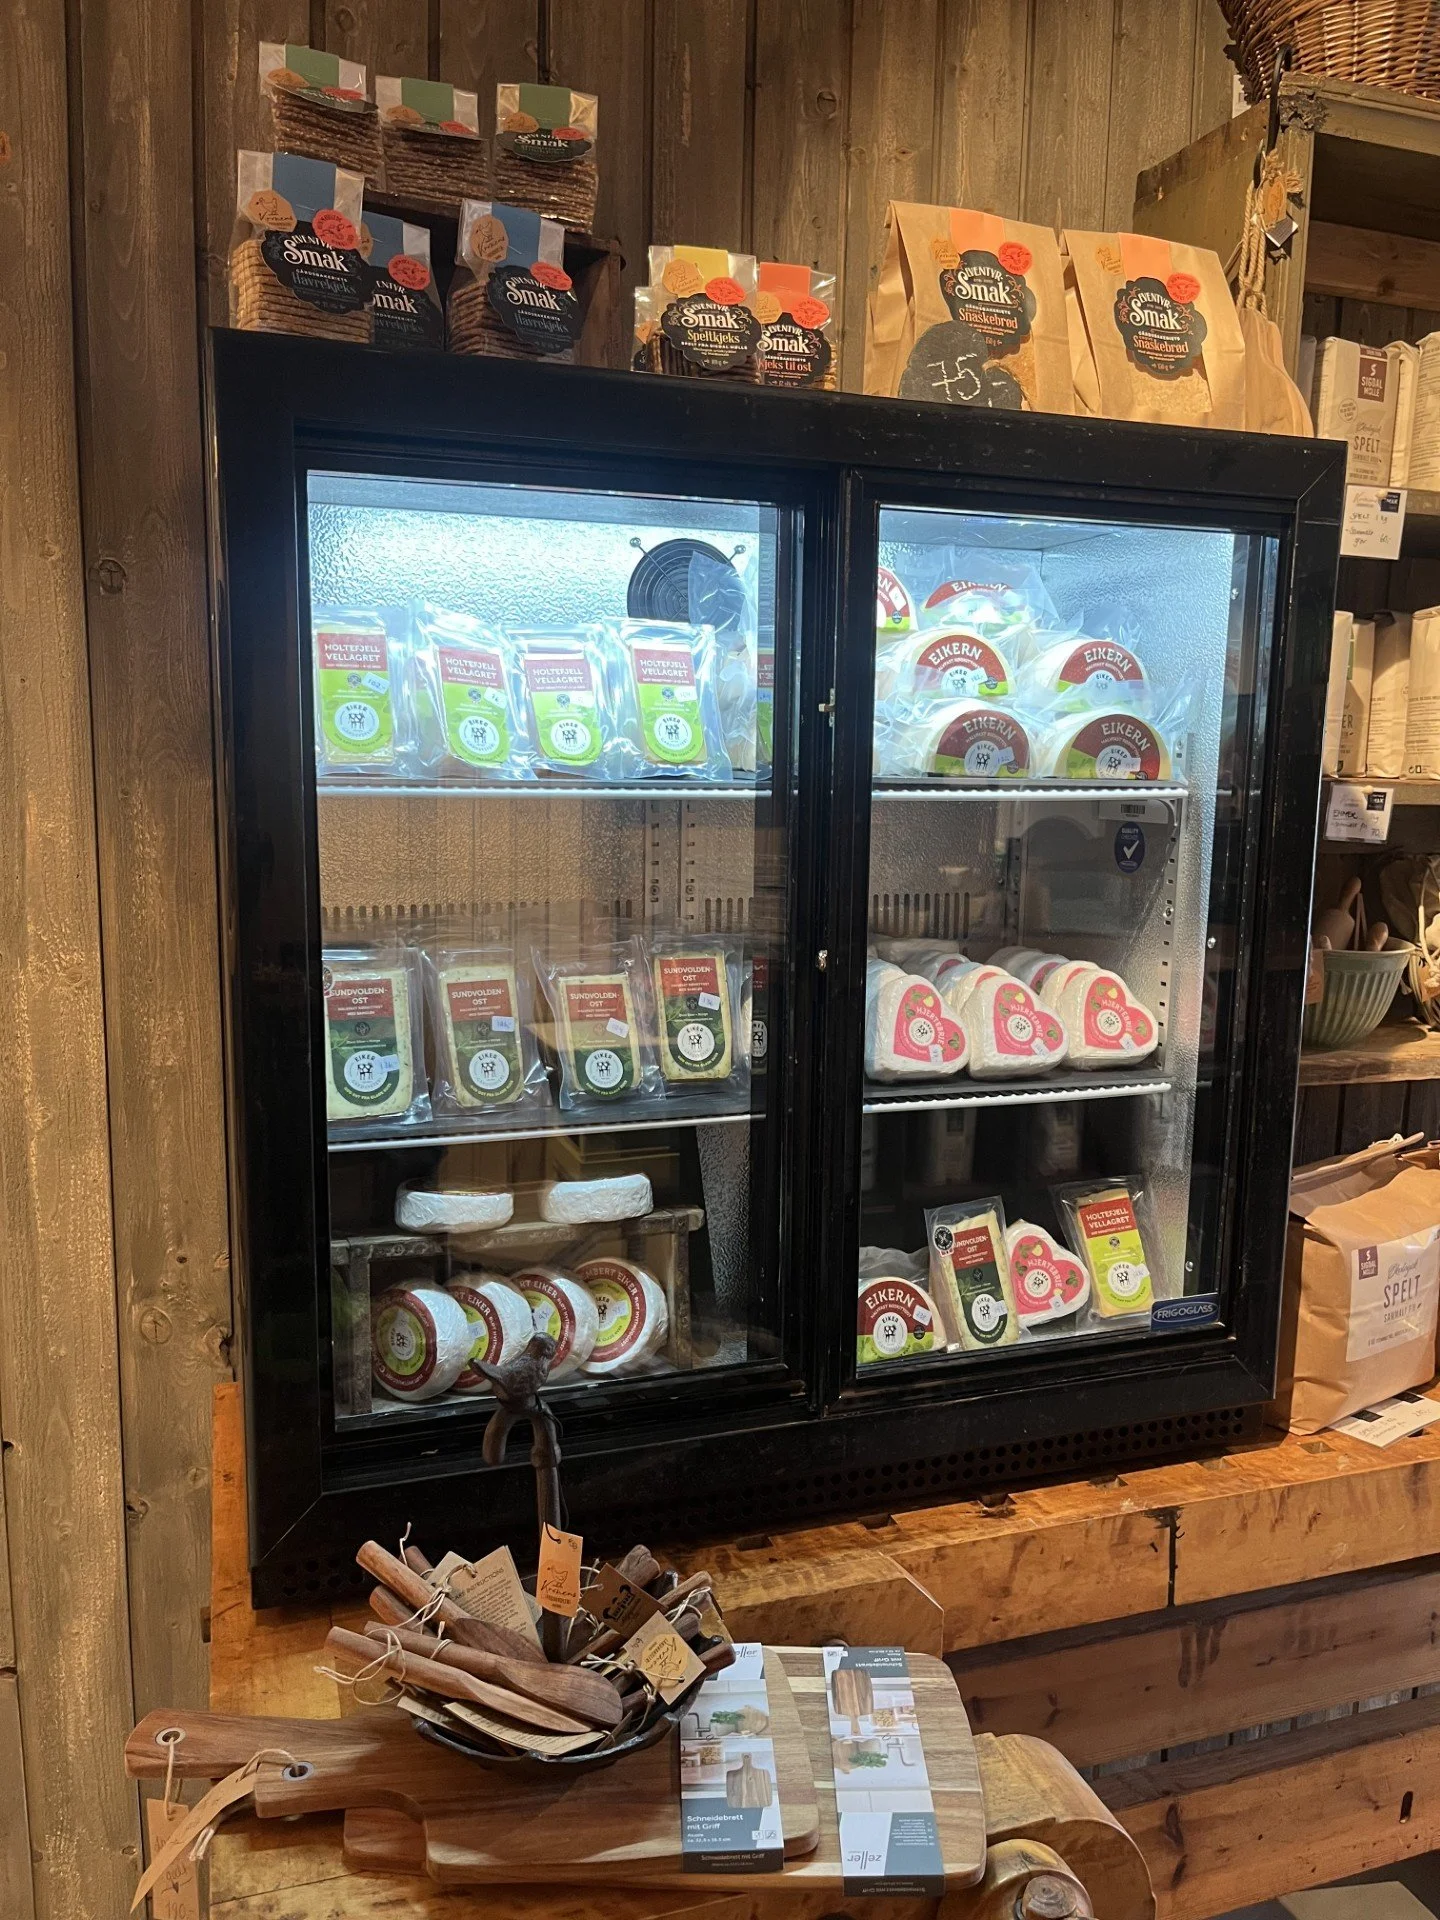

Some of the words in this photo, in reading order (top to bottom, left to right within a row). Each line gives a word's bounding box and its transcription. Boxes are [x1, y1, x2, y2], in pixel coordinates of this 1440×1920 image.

[515, 135, 569, 147] Smak
[283, 239, 350, 272] Smak
[966, 266, 1003, 281] EVENTYR-
[955, 271, 1013, 304] Smak
[506, 281, 562, 311] Smak
[1138, 292, 1172, 309] EVENTYR-
[681, 307, 740, 328] Smak
[959, 307, 1018, 329] Snaskebrød
[1130, 298, 1182, 330] Smak
[687, 329, 740, 344] Speltkjeks
[757, 330, 811, 354] Smak
[1133, 335, 1189, 353] Snaskebrød
[785, 361, 796, 371] til
[797, 362, 812, 372] ost
[1362, 376, 1383, 389] SIGDAL
[1354, 436, 1380, 453] SPELT
[325, 643, 380, 653] HOLTEFJELL
[928, 643, 982, 666] EIKERN
[326, 653, 380, 662] VELLAGRET
[446, 657, 498, 671] HOLTEFJELL
[640, 659, 688, 669] HOLTEFJELL
[1084, 647, 1132, 672] EIKERN
[448, 667, 497, 679] VELLAGRET
[642, 667, 688, 677] VELLAGRET
[535, 676, 583, 684] VELLAGRET
[963, 716, 1016, 740] EIKERN
[1101, 722, 1151, 752] EIKERN
[664, 966, 713, 974] SUNDVOLDEN-
[329, 987, 389, 997] SUNDVOLDEN-
[452, 989, 504, 998] SUNDVOLDEN-
[570, 992, 620, 1000] SUNDVOLDEN-
[916, 1006, 945, 1045] HJERTEBRIE
[1010, 1004, 1044, 1038] HJERTEBRIE
[354, 1054, 376, 1062] EIKER
[478, 1053, 498, 1061] EIKER
[1086, 1208, 1128, 1221] HOLTEFJELL
[1088, 1216, 1130, 1229] VELLAGRET
[967, 1245, 978, 1253] OST
[1027, 1259, 1063, 1287] HJERTEBRIE
[533, 1282, 558, 1298] EIKER
[616, 1272, 638, 1296] EIKER
[865, 1289, 914, 1309] EIKERN
[1383, 1275, 1421, 1309] SPELT
[467, 1295, 491, 1316] EIKER
[1157, 1304, 1214, 1319] FRIGOGLASS
[881, 1316, 899, 1324] EIKER
[466, 1566, 505, 1593] INSTRUCTIONS
[686, 1814, 744, 1822] Schneidebrett
[847, 1850, 882, 1870] zeller
